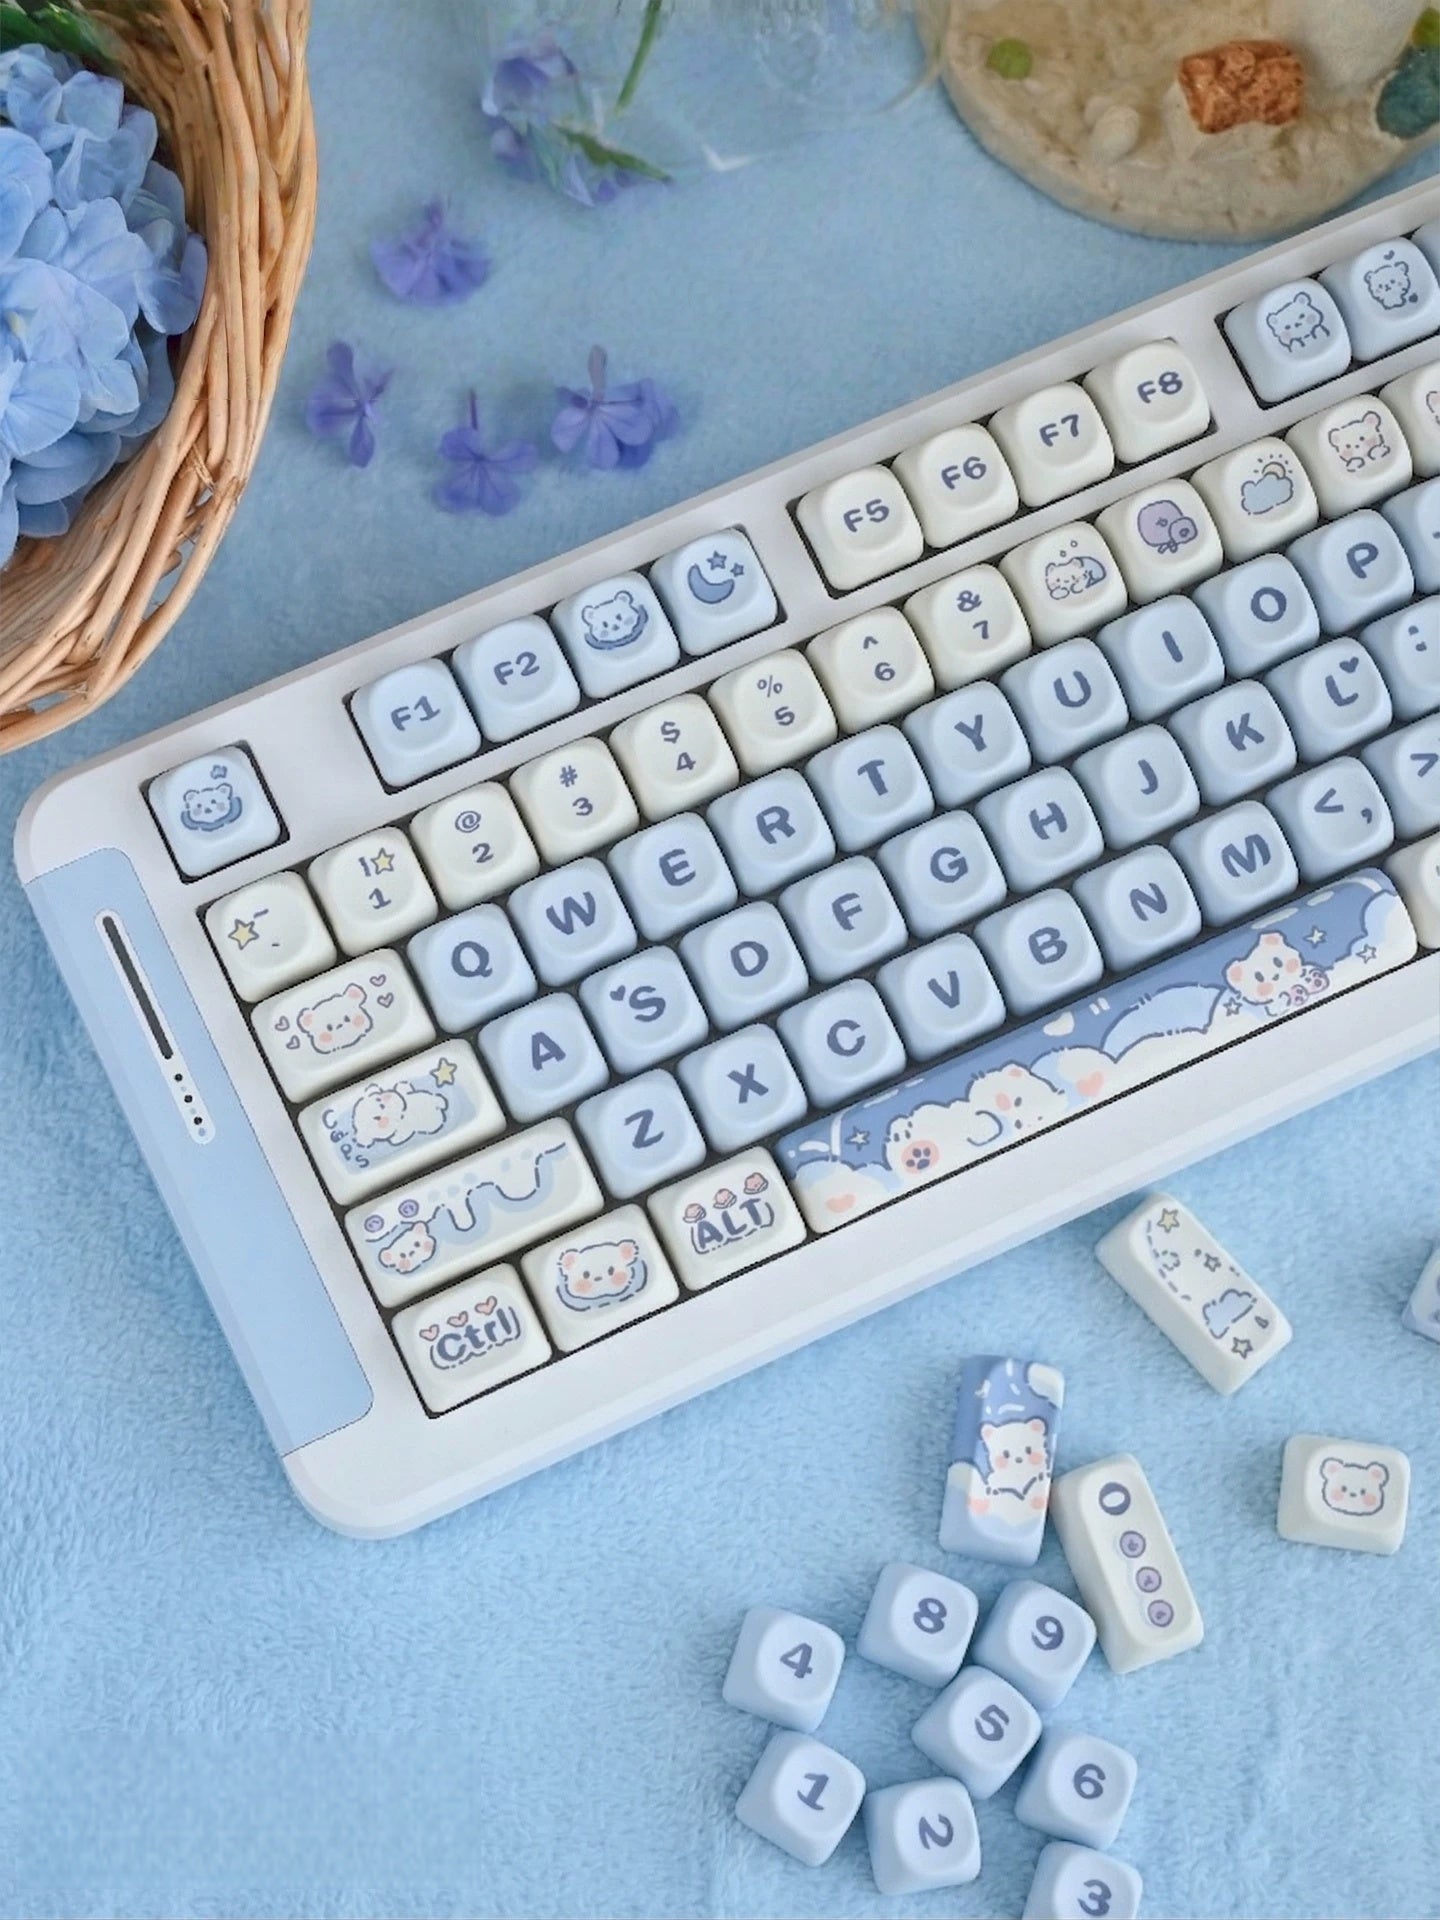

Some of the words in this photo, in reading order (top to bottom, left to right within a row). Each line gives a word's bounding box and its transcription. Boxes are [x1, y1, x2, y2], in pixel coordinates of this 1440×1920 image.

[1137, 371, 1184, 404] F8
[1039, 413, 1080, 448] F7
[941, 456, 987, 491] F6
[843, 498, 890, 533] F5
[1345, 542, 1380, 580] P
[956, 590, 983, 613] &
[1250, 586, 1288, 623] O
[972, 619, 990, 640] 7
[1161, 630, 1184, 663] I
[493, 651, 541, 686] F2
[756, 674, 783, 698] %
[874, 662, 896, 682] 6
[1053, 670, 1092, 709] U
[1324, 674, 1360, 707] L
[390, 695, 441, 732] F1
[774, 706, 796, 727] 5
[1225, 712, 1266, 752] K
[660, 721, 681, 745] $
[954, 714, 988, 753] Y
[559, 764, 579, 788] #
[676, 751, 697, 771] 4
[857, 759, 889, 797] T
[1137, 759, 1159, 796] J
[454, 810, 482, 834] @
[572, 797, 594, 817] 3
[755, 805, 796, 845] R
[1028, 801, 1068, 841] H
[472, 842, 494, 864] 2
[658, 848, 697, 887] E
[929, 846, 969, 884] G
[1221, 833, 1272, 878] M
[368, 887, 392, 910] 1
[545, 891, 597, 936] W
[831, 892, 863, 932] F
[1129, 882, 1168, 922] N
[450, 940, 493, 978] Q
[730, 940, 769, 978] D
[1028, 926, 1068, 965] B
[628, 985, 667, 1023] S
[927, 970, 961, 1009] V
[531, 1031, 567, 1071] A
[826, 1019, 866, 1057] C
[727, 1063, 769, 1104] X
[624, 1108, 665, 1150] Z
[697, 1198, 762, 1250] ALT
[436, 1307, 513, 1362] Ctrl
[913, 1597, 948, 1635] 8
[1031, 1615, 1065, 1651] 9
[779, 1642, 813, 1680] 4
[974, 1704, 1010, 1742] 5
[797, 1773, 830, 1811] 1
[1073, 1763, 1107, 1800] 6
[918, 1813, 954, 1850] 2
[1077, 1878, 1113, 1917] 3
